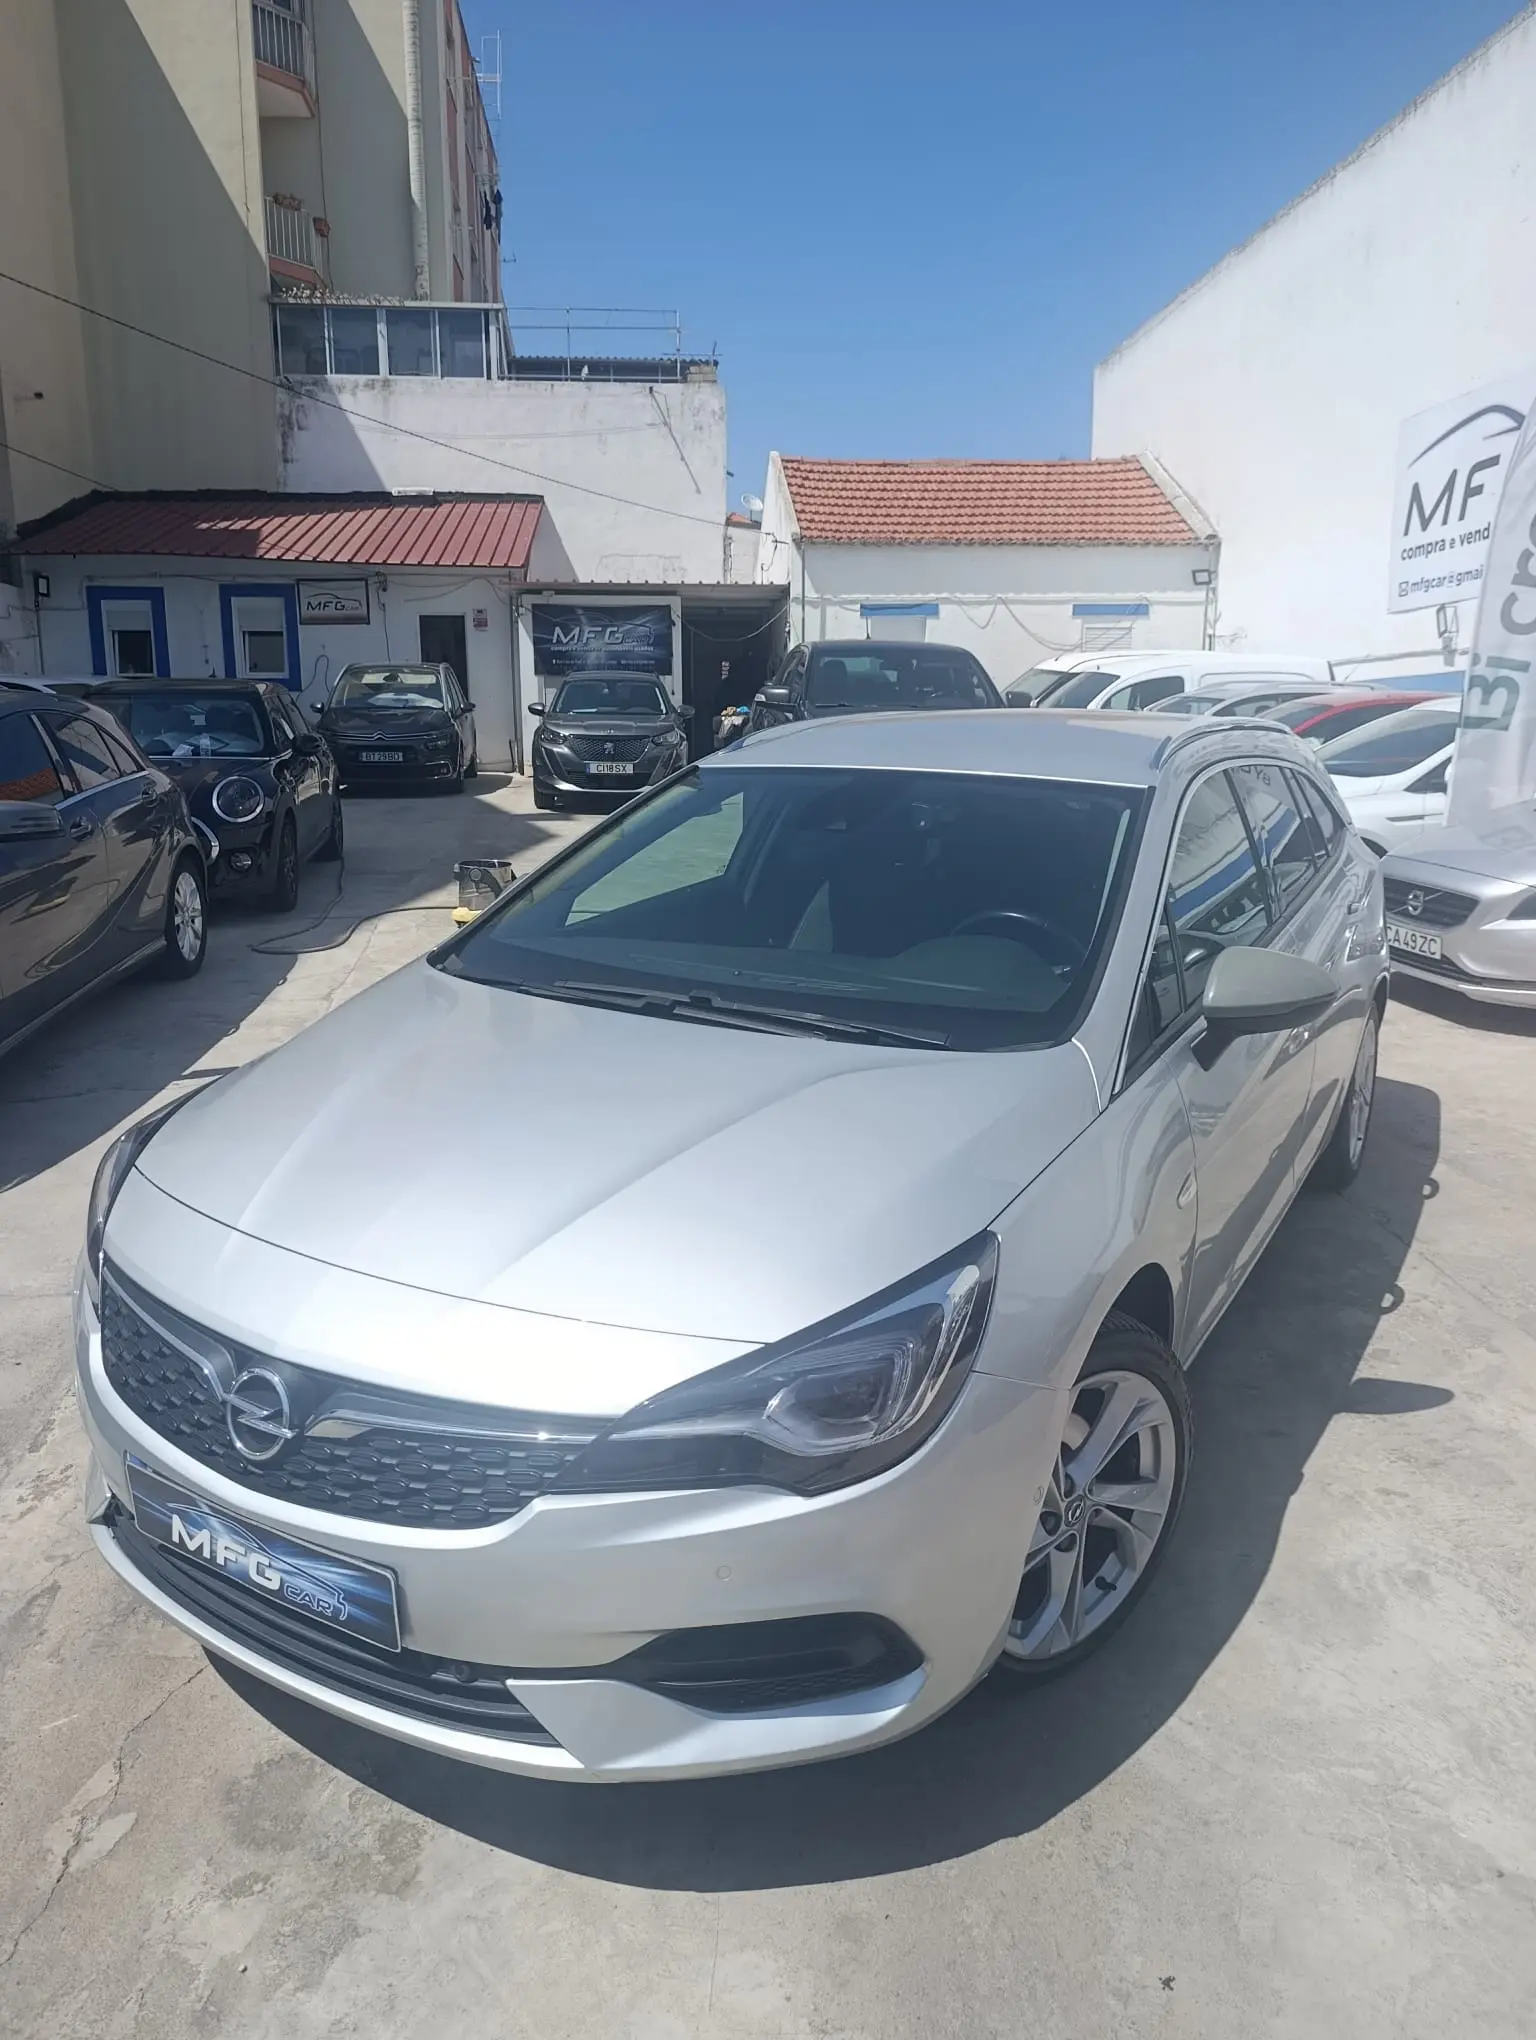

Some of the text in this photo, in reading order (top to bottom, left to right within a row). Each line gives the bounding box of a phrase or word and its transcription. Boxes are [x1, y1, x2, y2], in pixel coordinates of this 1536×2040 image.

[1401, 538, 1446, 561] compra
[1449, 538, 1456, 549] e
[306, 601, 345, 611] MFG
[1463, 510, 1536, 732] Bi cr
[552, 626, 624, 644] MFG
[172, 1514, 333, 1616] MFG CAR
